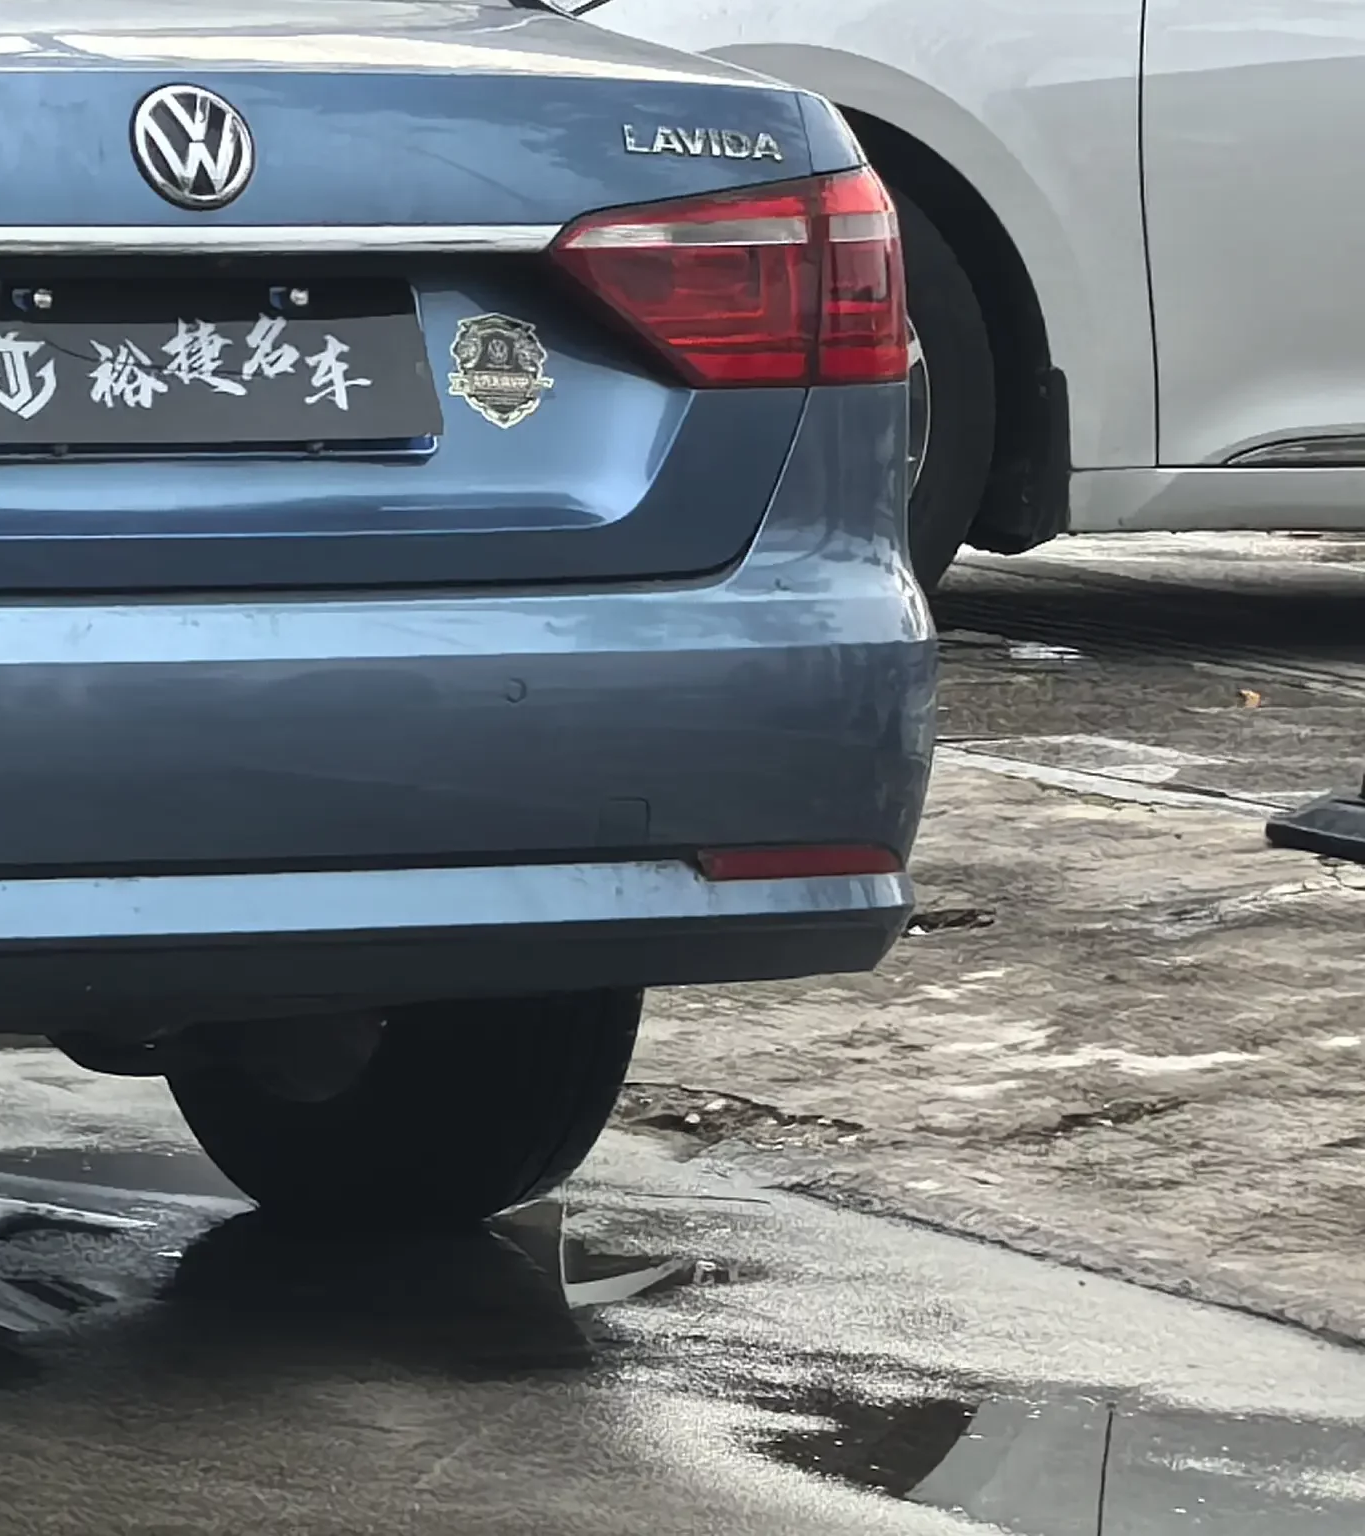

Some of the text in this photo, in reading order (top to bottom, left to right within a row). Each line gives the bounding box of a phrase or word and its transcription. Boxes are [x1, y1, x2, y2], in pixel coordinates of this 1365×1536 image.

[622, 123, 784, 163] LAVIDA
[88, 312, 373, 412] 裕捷名车
